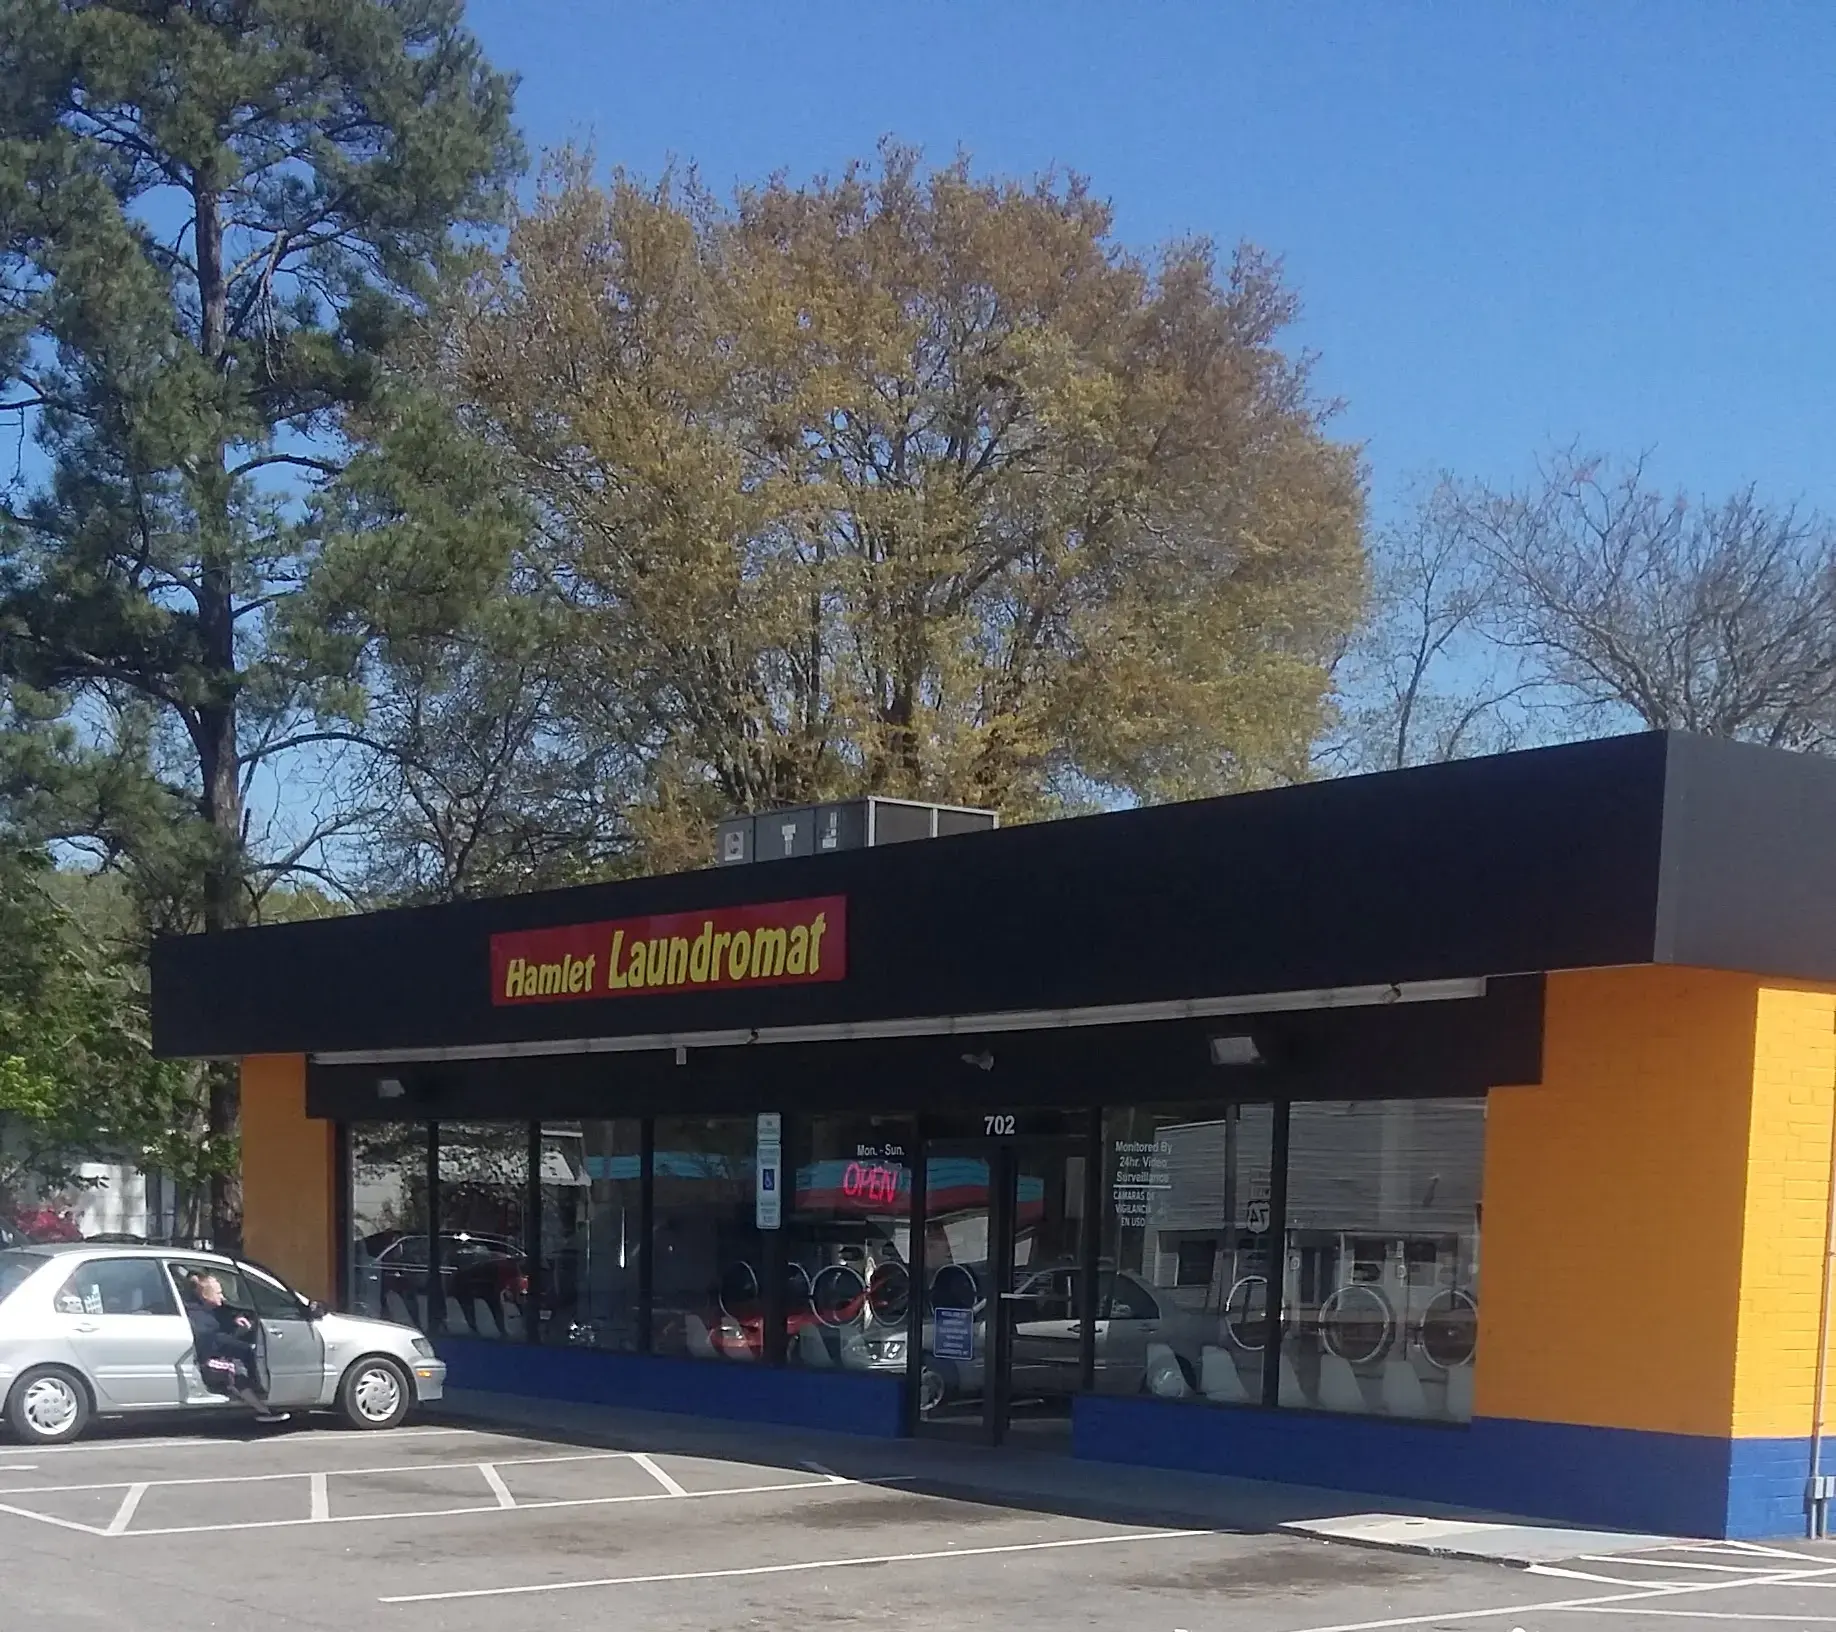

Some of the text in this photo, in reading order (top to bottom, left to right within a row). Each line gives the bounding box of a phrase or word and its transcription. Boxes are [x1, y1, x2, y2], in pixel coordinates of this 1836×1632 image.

[505, 911, 827, 998] Hamlet Laundromat
[984, 1115, 1015, 1135] 702
[1115, 1141, 1173, 1154] Monitored By
[1142, 1156, 1167, 1168] Video
[843, 1162, 898, 1204] OPEN
[1116, 1171, 1170, 1183] Surveillance
[1121, 1217, 1130, 1227] EN
